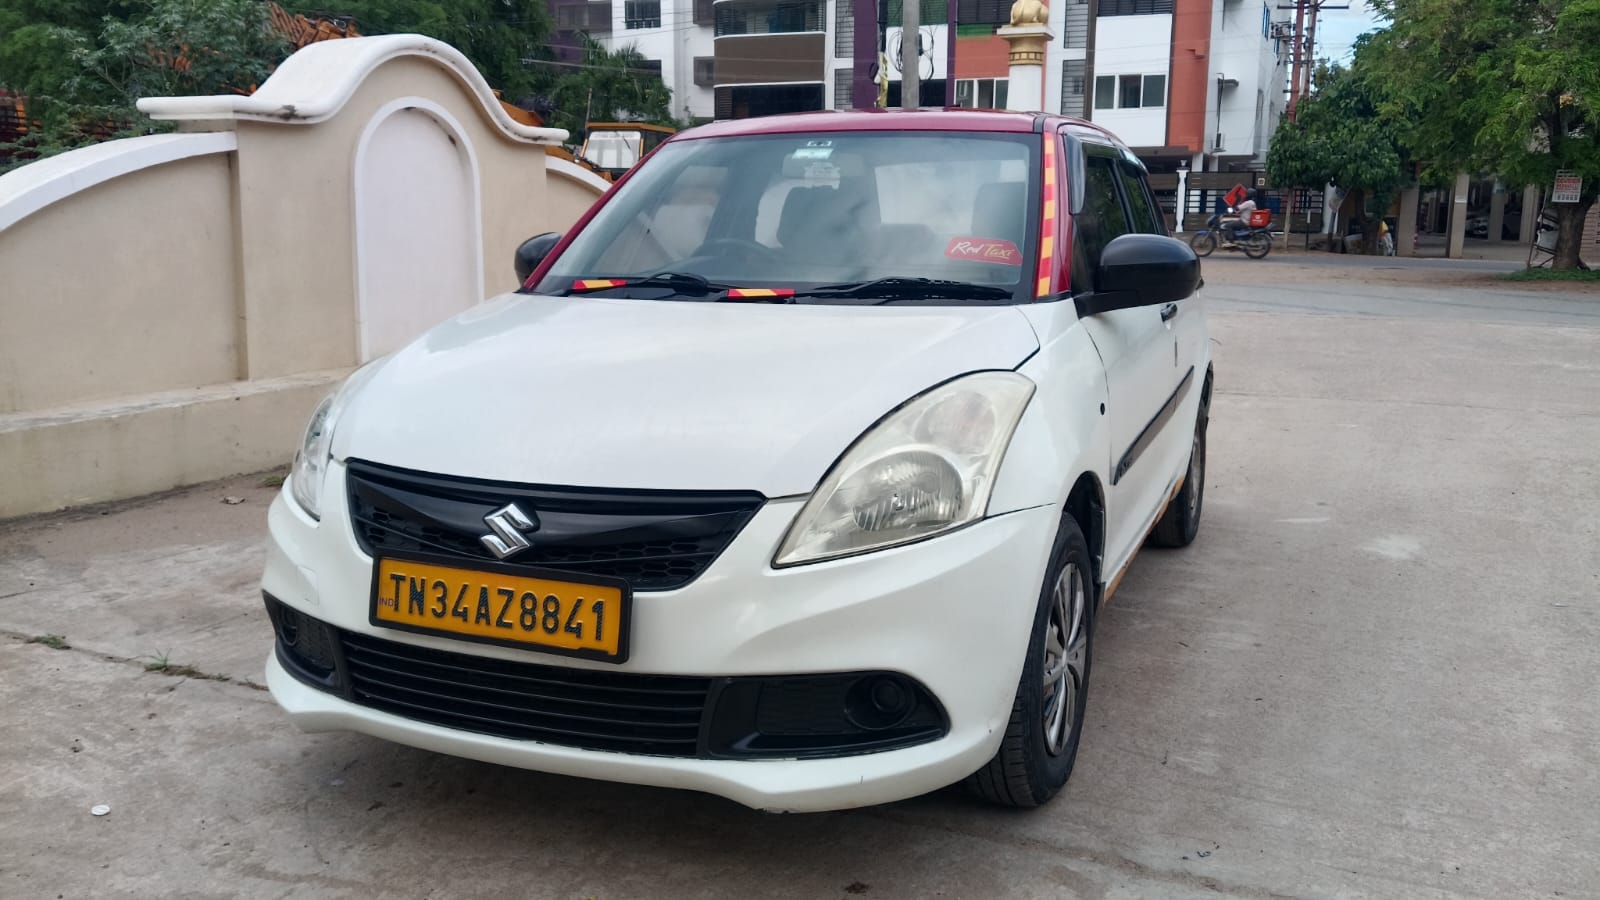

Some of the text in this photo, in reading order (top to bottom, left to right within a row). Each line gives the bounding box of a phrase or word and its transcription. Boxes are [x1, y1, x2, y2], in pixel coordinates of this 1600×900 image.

[951, 241, 985, 255] Red
[379, 597, 394, 607] IND
[389, 572, 605, 642] TN34AZ8841
